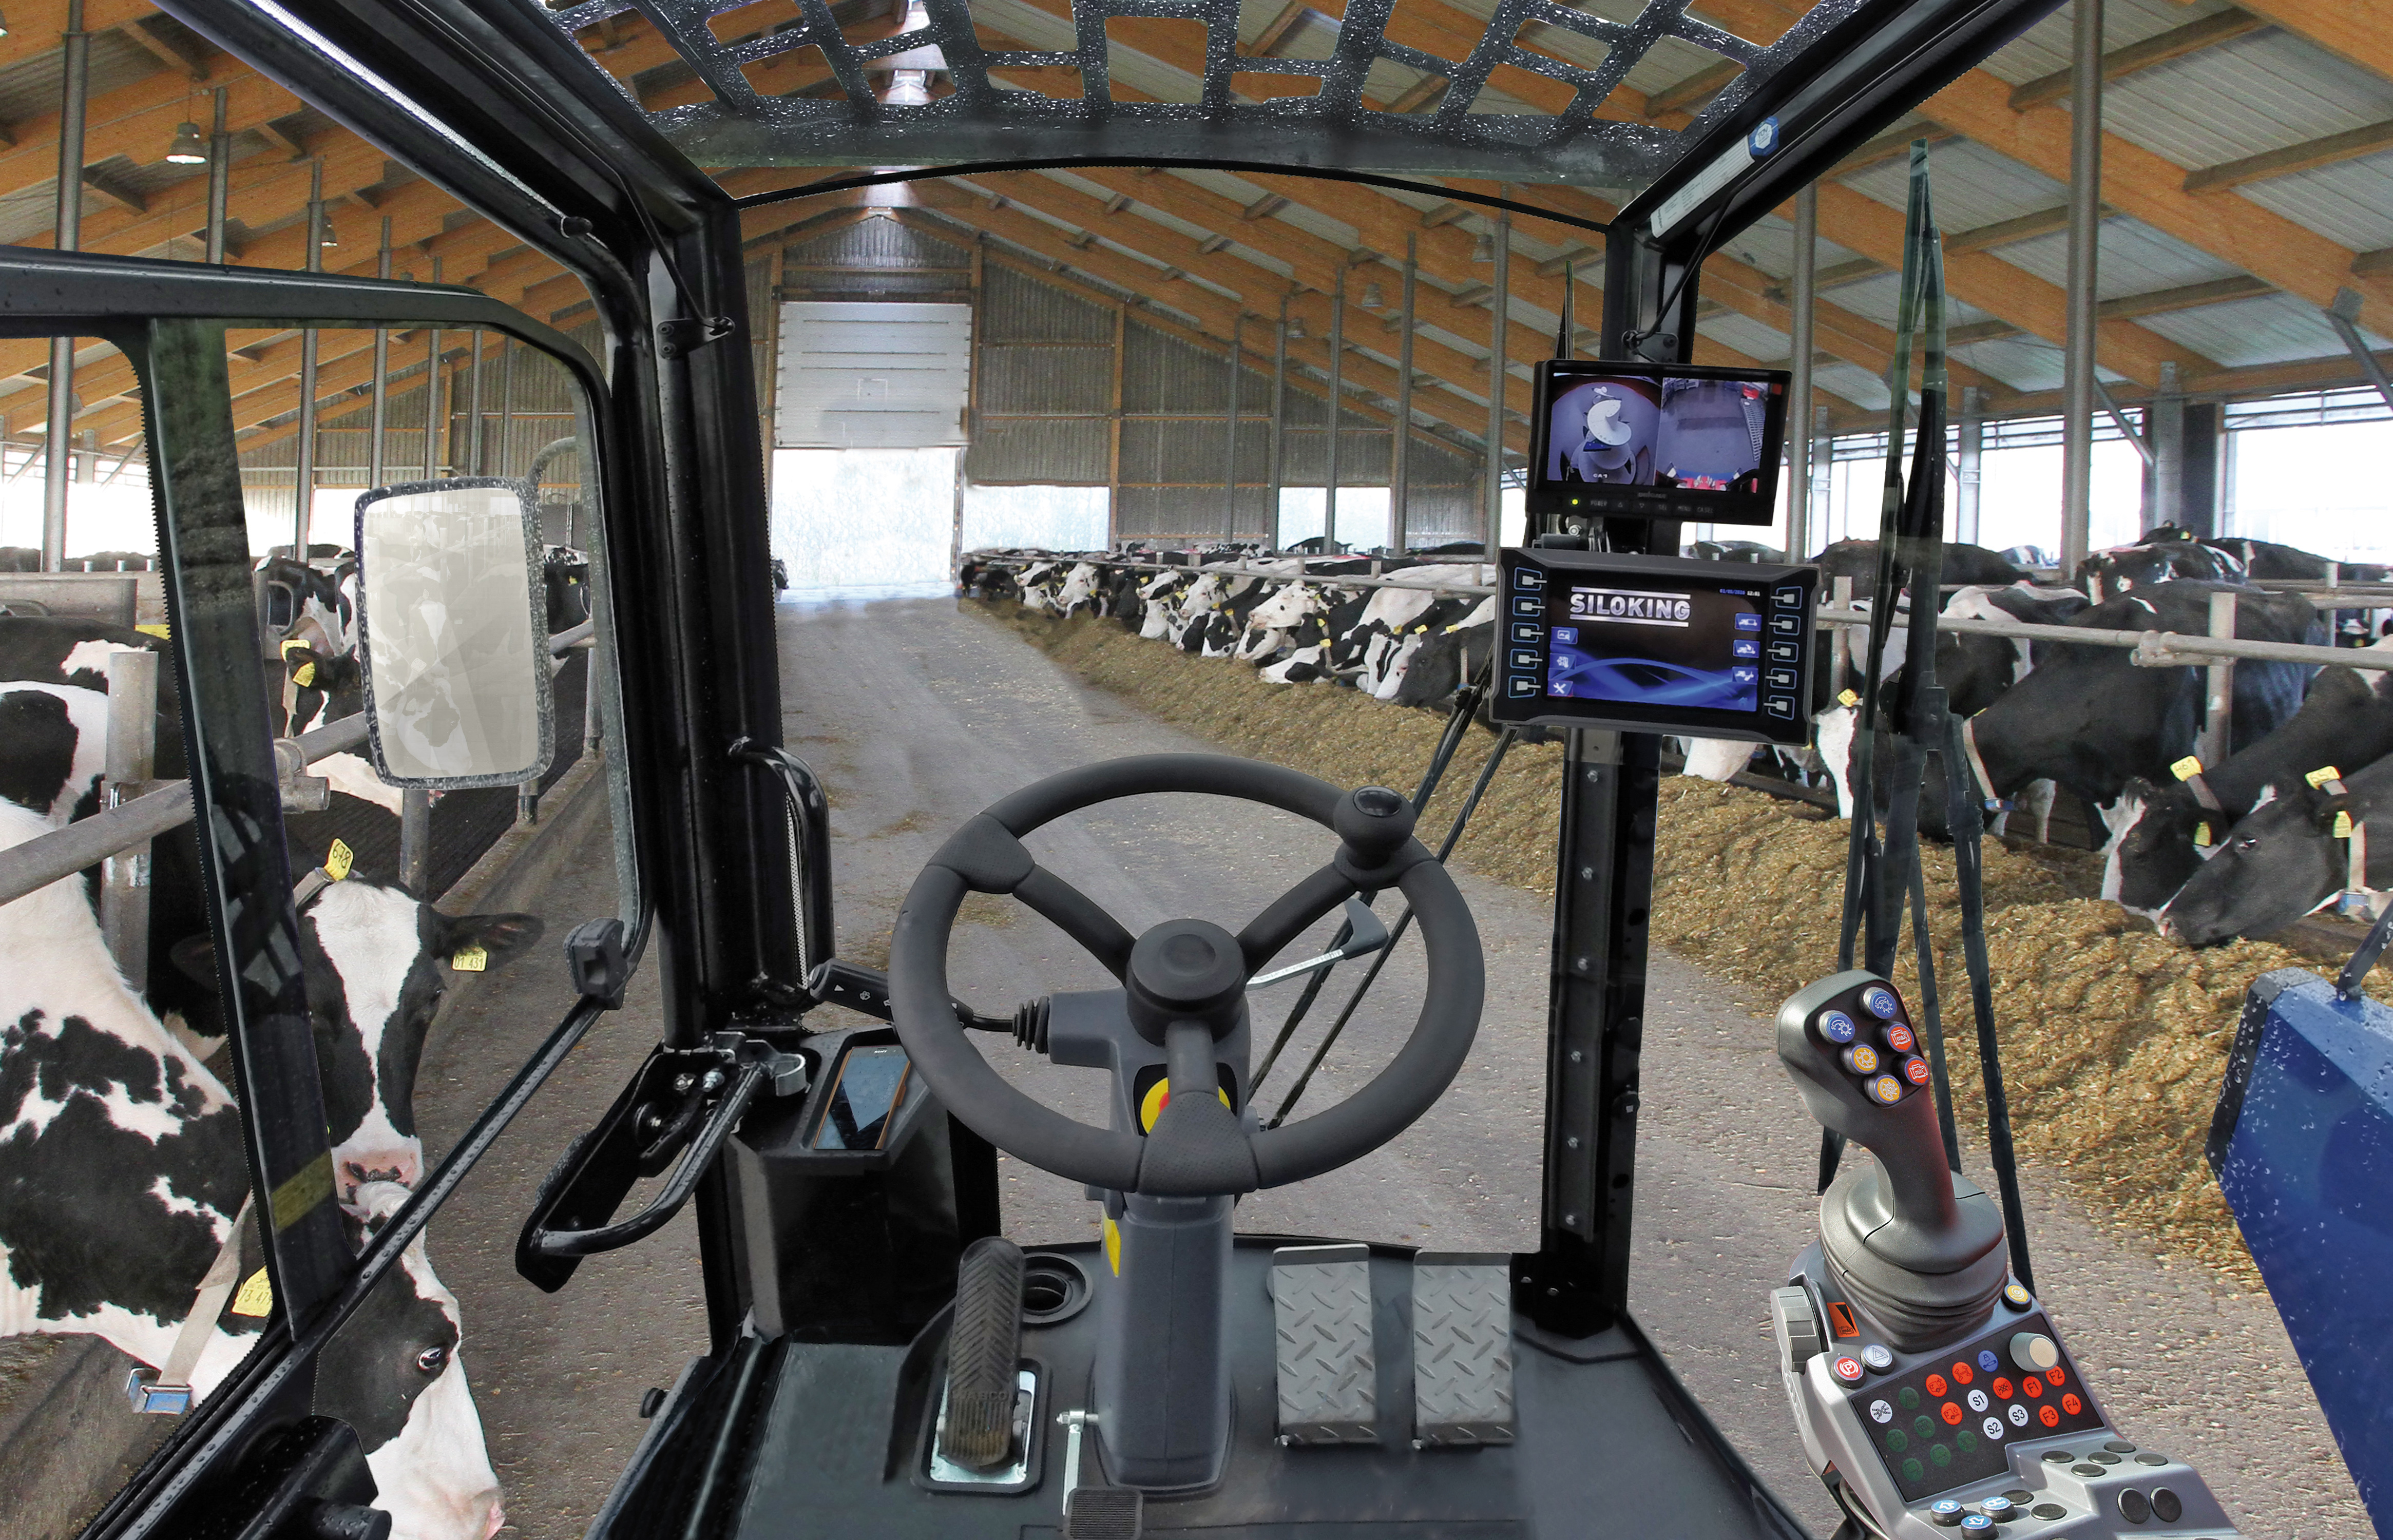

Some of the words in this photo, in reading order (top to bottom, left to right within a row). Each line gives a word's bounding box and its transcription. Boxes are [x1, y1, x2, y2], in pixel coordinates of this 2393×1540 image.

[1569, 593, 1691, 620] SILOKING
[332, 842, 351, 869] 678
[469, 957, 484, 969] 431
[2049, 1369, 2063, 1382] F2
[2026, 1381, 2039, 1393] F1
[1973, 1394, 1985, 1407] S1
[2065, 1397, 2079, 1411] F4
[2012, 1409, 2025, 1421] S3
[2042, 1409, 2056, 1423] F3
[1987, 1422, 2001, 1435] S2
